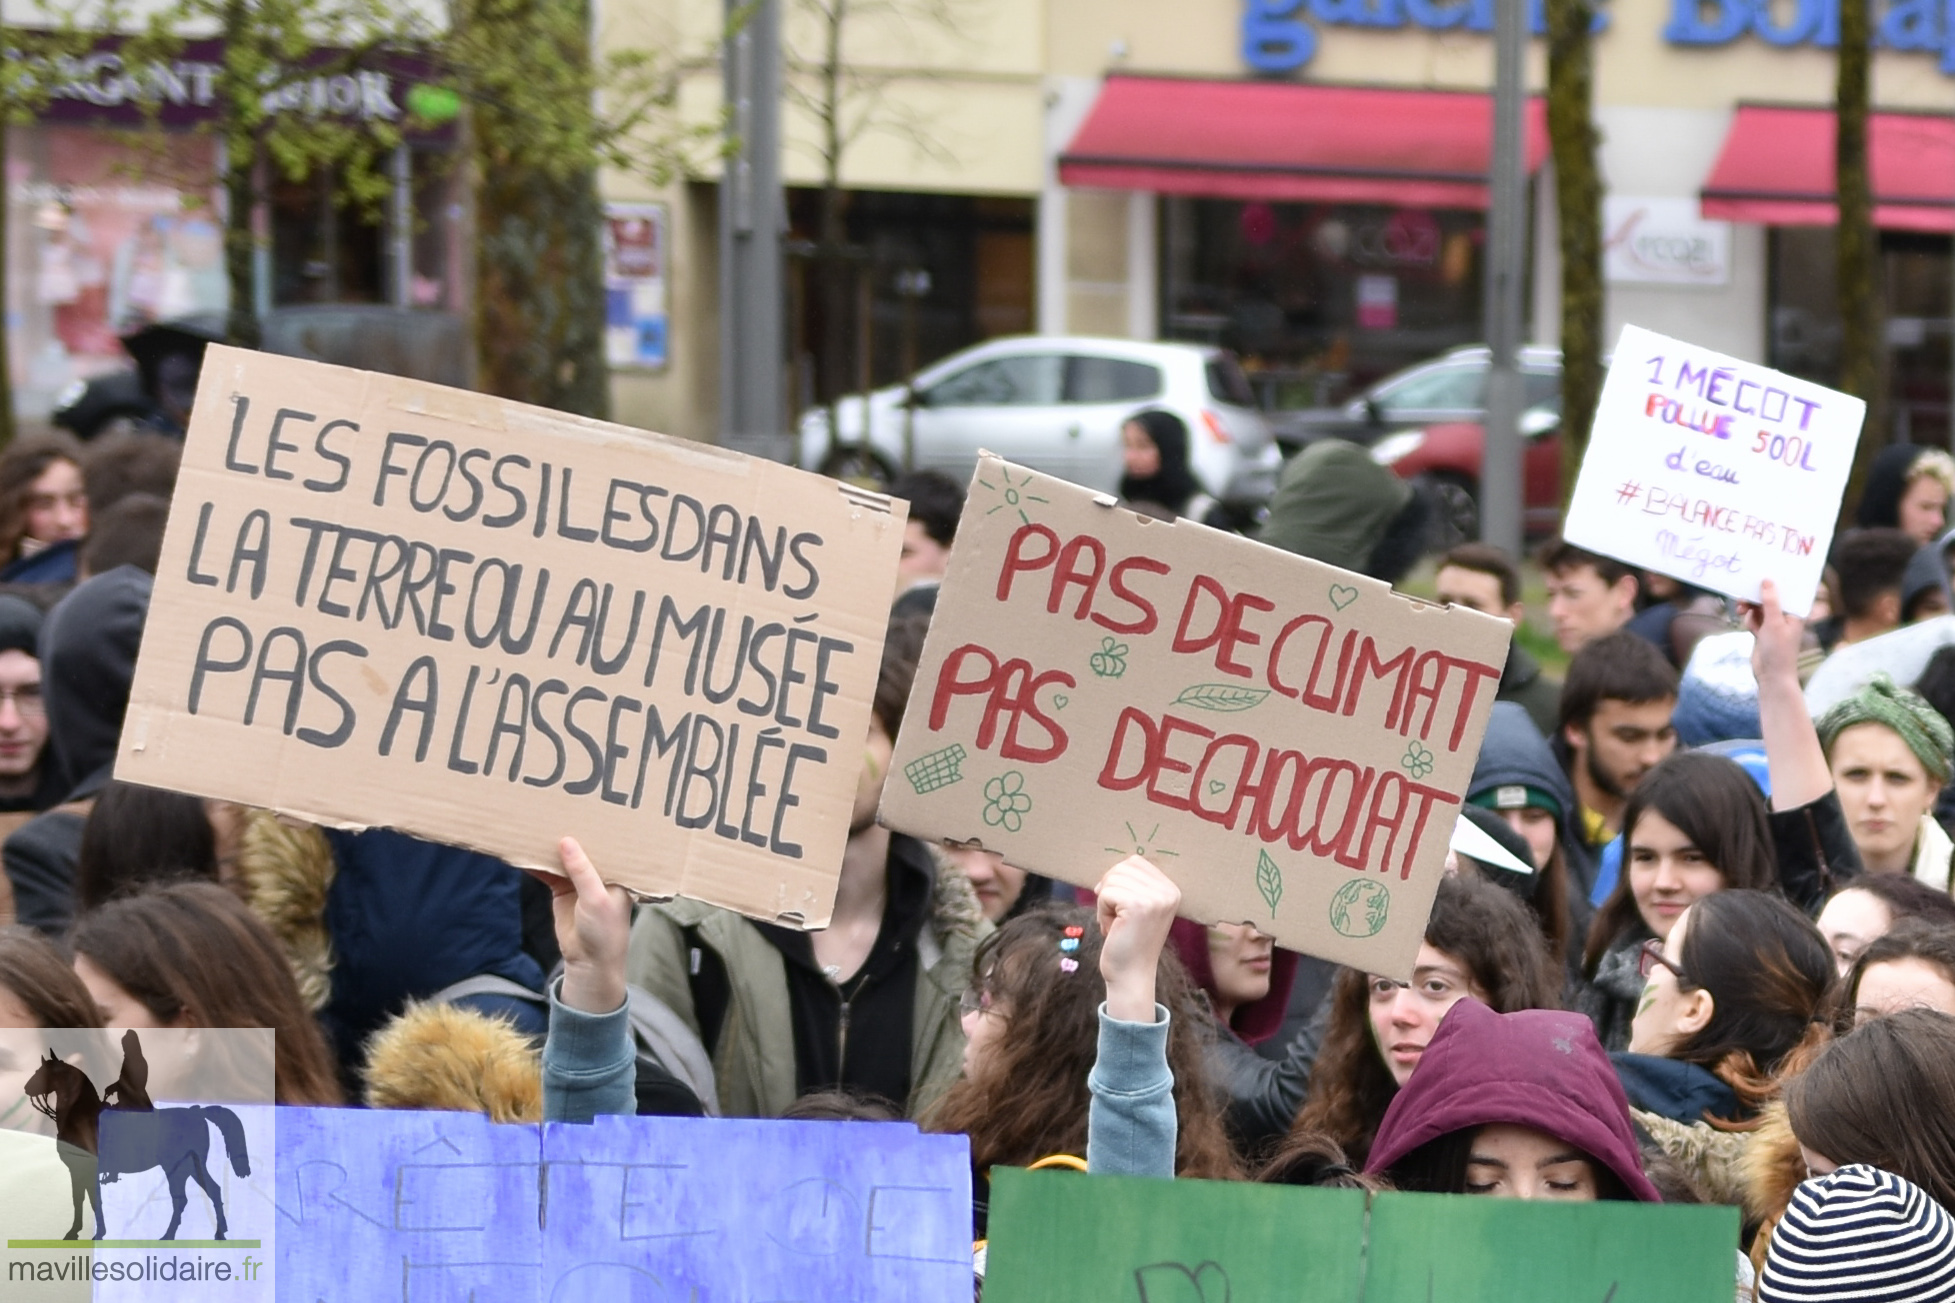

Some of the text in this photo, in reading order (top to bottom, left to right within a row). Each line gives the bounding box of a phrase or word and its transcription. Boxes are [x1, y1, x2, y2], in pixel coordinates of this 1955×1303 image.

[1645, 355, 1665, 385] 1
[1644, 393, 1817, 472] POLLUE 500L
[1665, 446, 1740, 485] d'eau
[225, 396, 824, 600] LES FOSSILES DANS
[1743, 514, 1776, 545] PAS
[1781, 525, 1815, 556] TON
[187, 501, 271, 600] LA
[290, 517, 475, 643] TERRE
[548, 577, 646, 676] AU
[643, 594, 854, 740] MUSÉE
[996, 523, 1171, 635] PAS
[1172, 574, 1275, 678] DE
[187, 616, 828, 859] PAS A L'ASSEMBLÉE
[928, 643, 1077, 763] PAS
